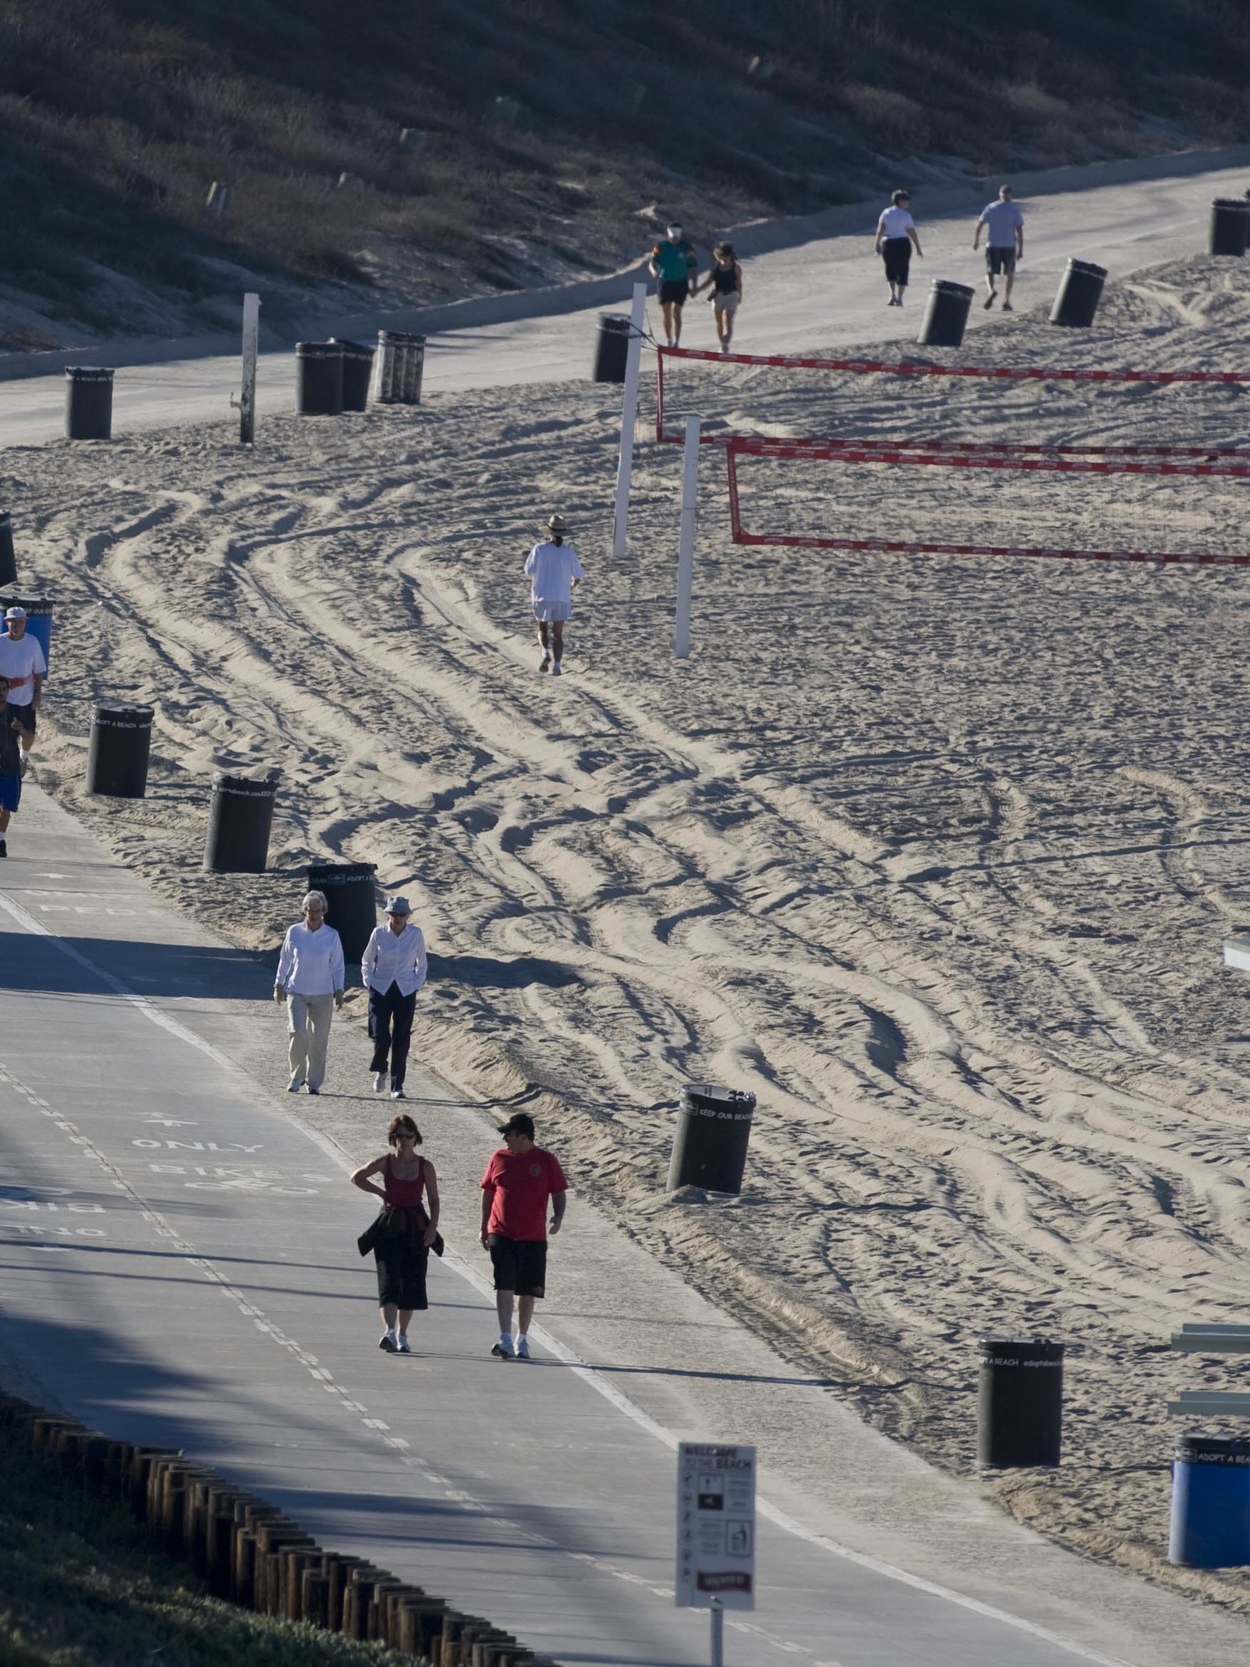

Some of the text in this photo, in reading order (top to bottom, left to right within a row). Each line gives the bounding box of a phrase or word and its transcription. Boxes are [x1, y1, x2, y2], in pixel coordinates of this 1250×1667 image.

[717, 1111, 733, 1120] OUR
[131, 1139, 265, 1153] ONLY
[1198, 1453, 1226, 1461] ADOPT
